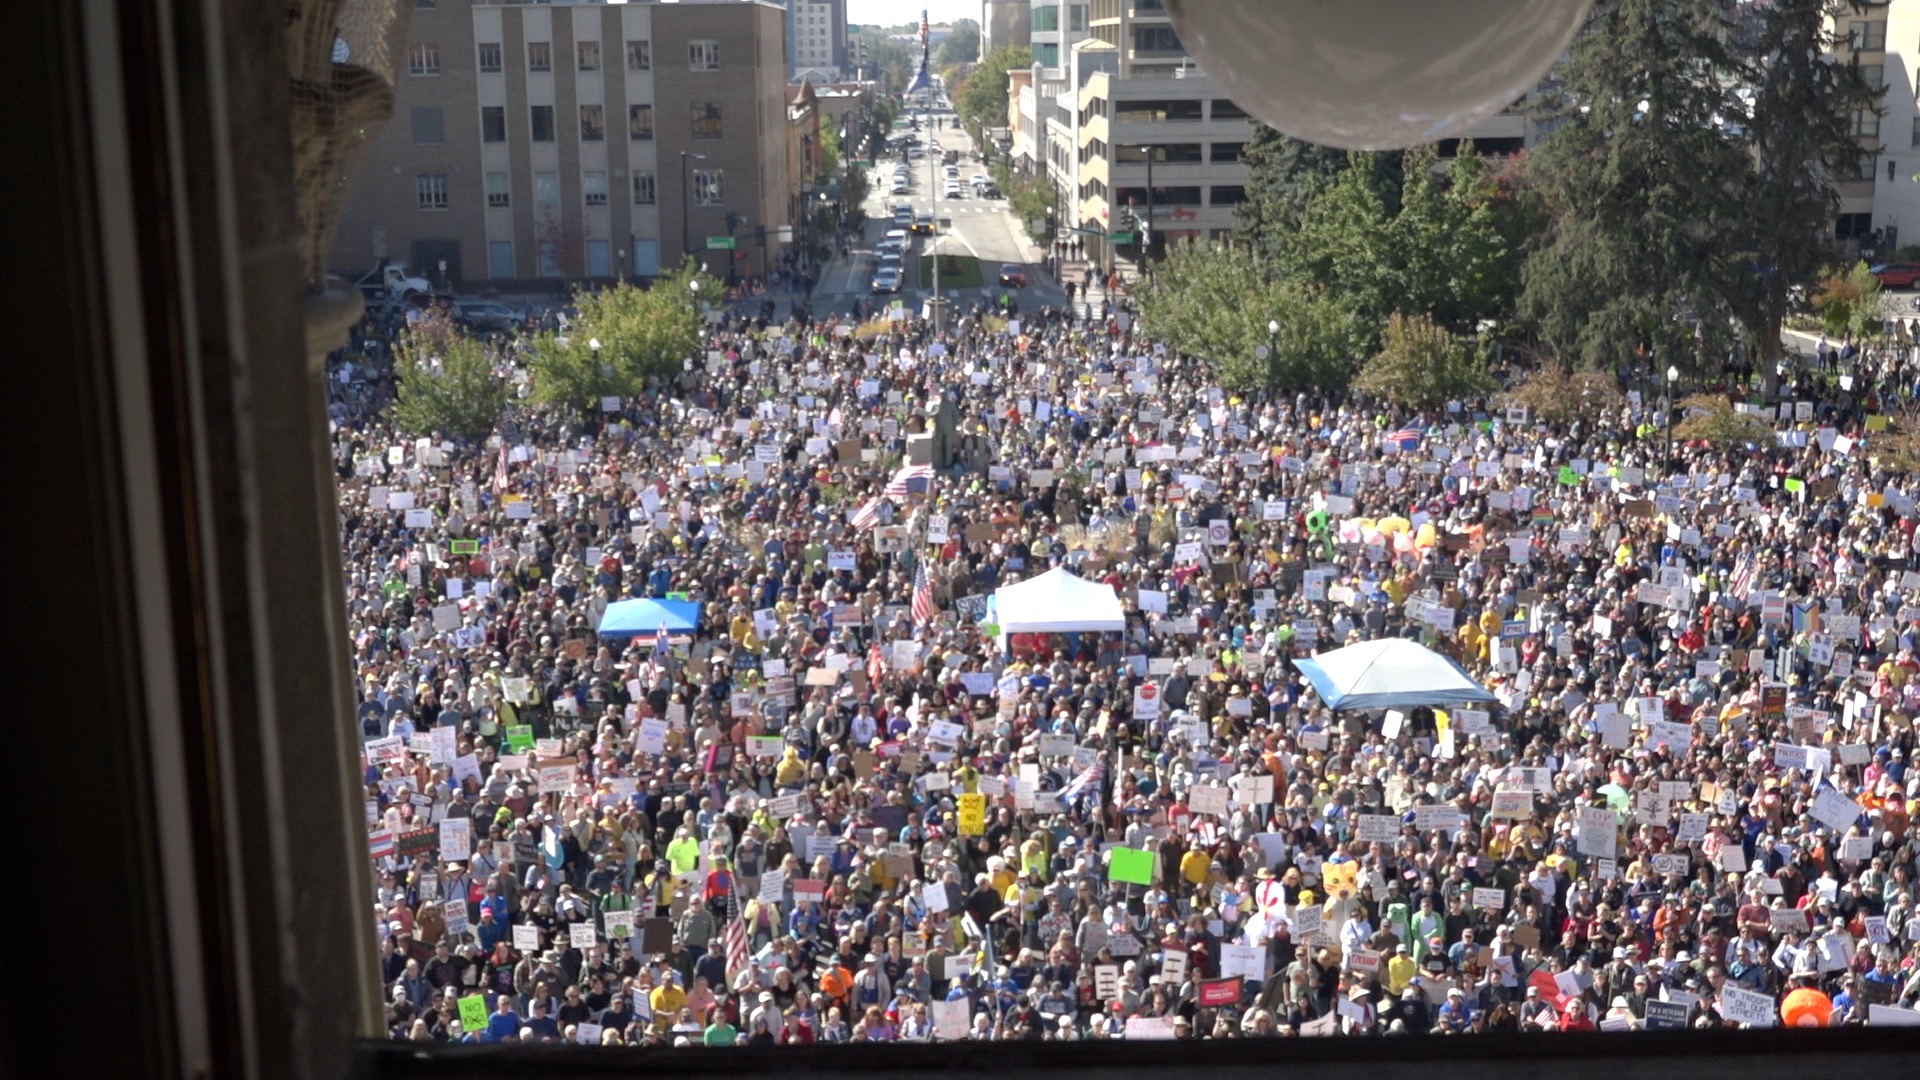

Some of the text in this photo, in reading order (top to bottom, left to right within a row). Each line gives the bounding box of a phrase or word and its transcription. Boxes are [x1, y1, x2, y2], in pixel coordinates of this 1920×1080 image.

[1725, 989, 1772, 1008] NO TROOPS
[1735, 999, 1766, 1013] ON OUR
[465, 1003, 481, 1013] NO
[1729, 1006, 1765, 1022] STREETS
